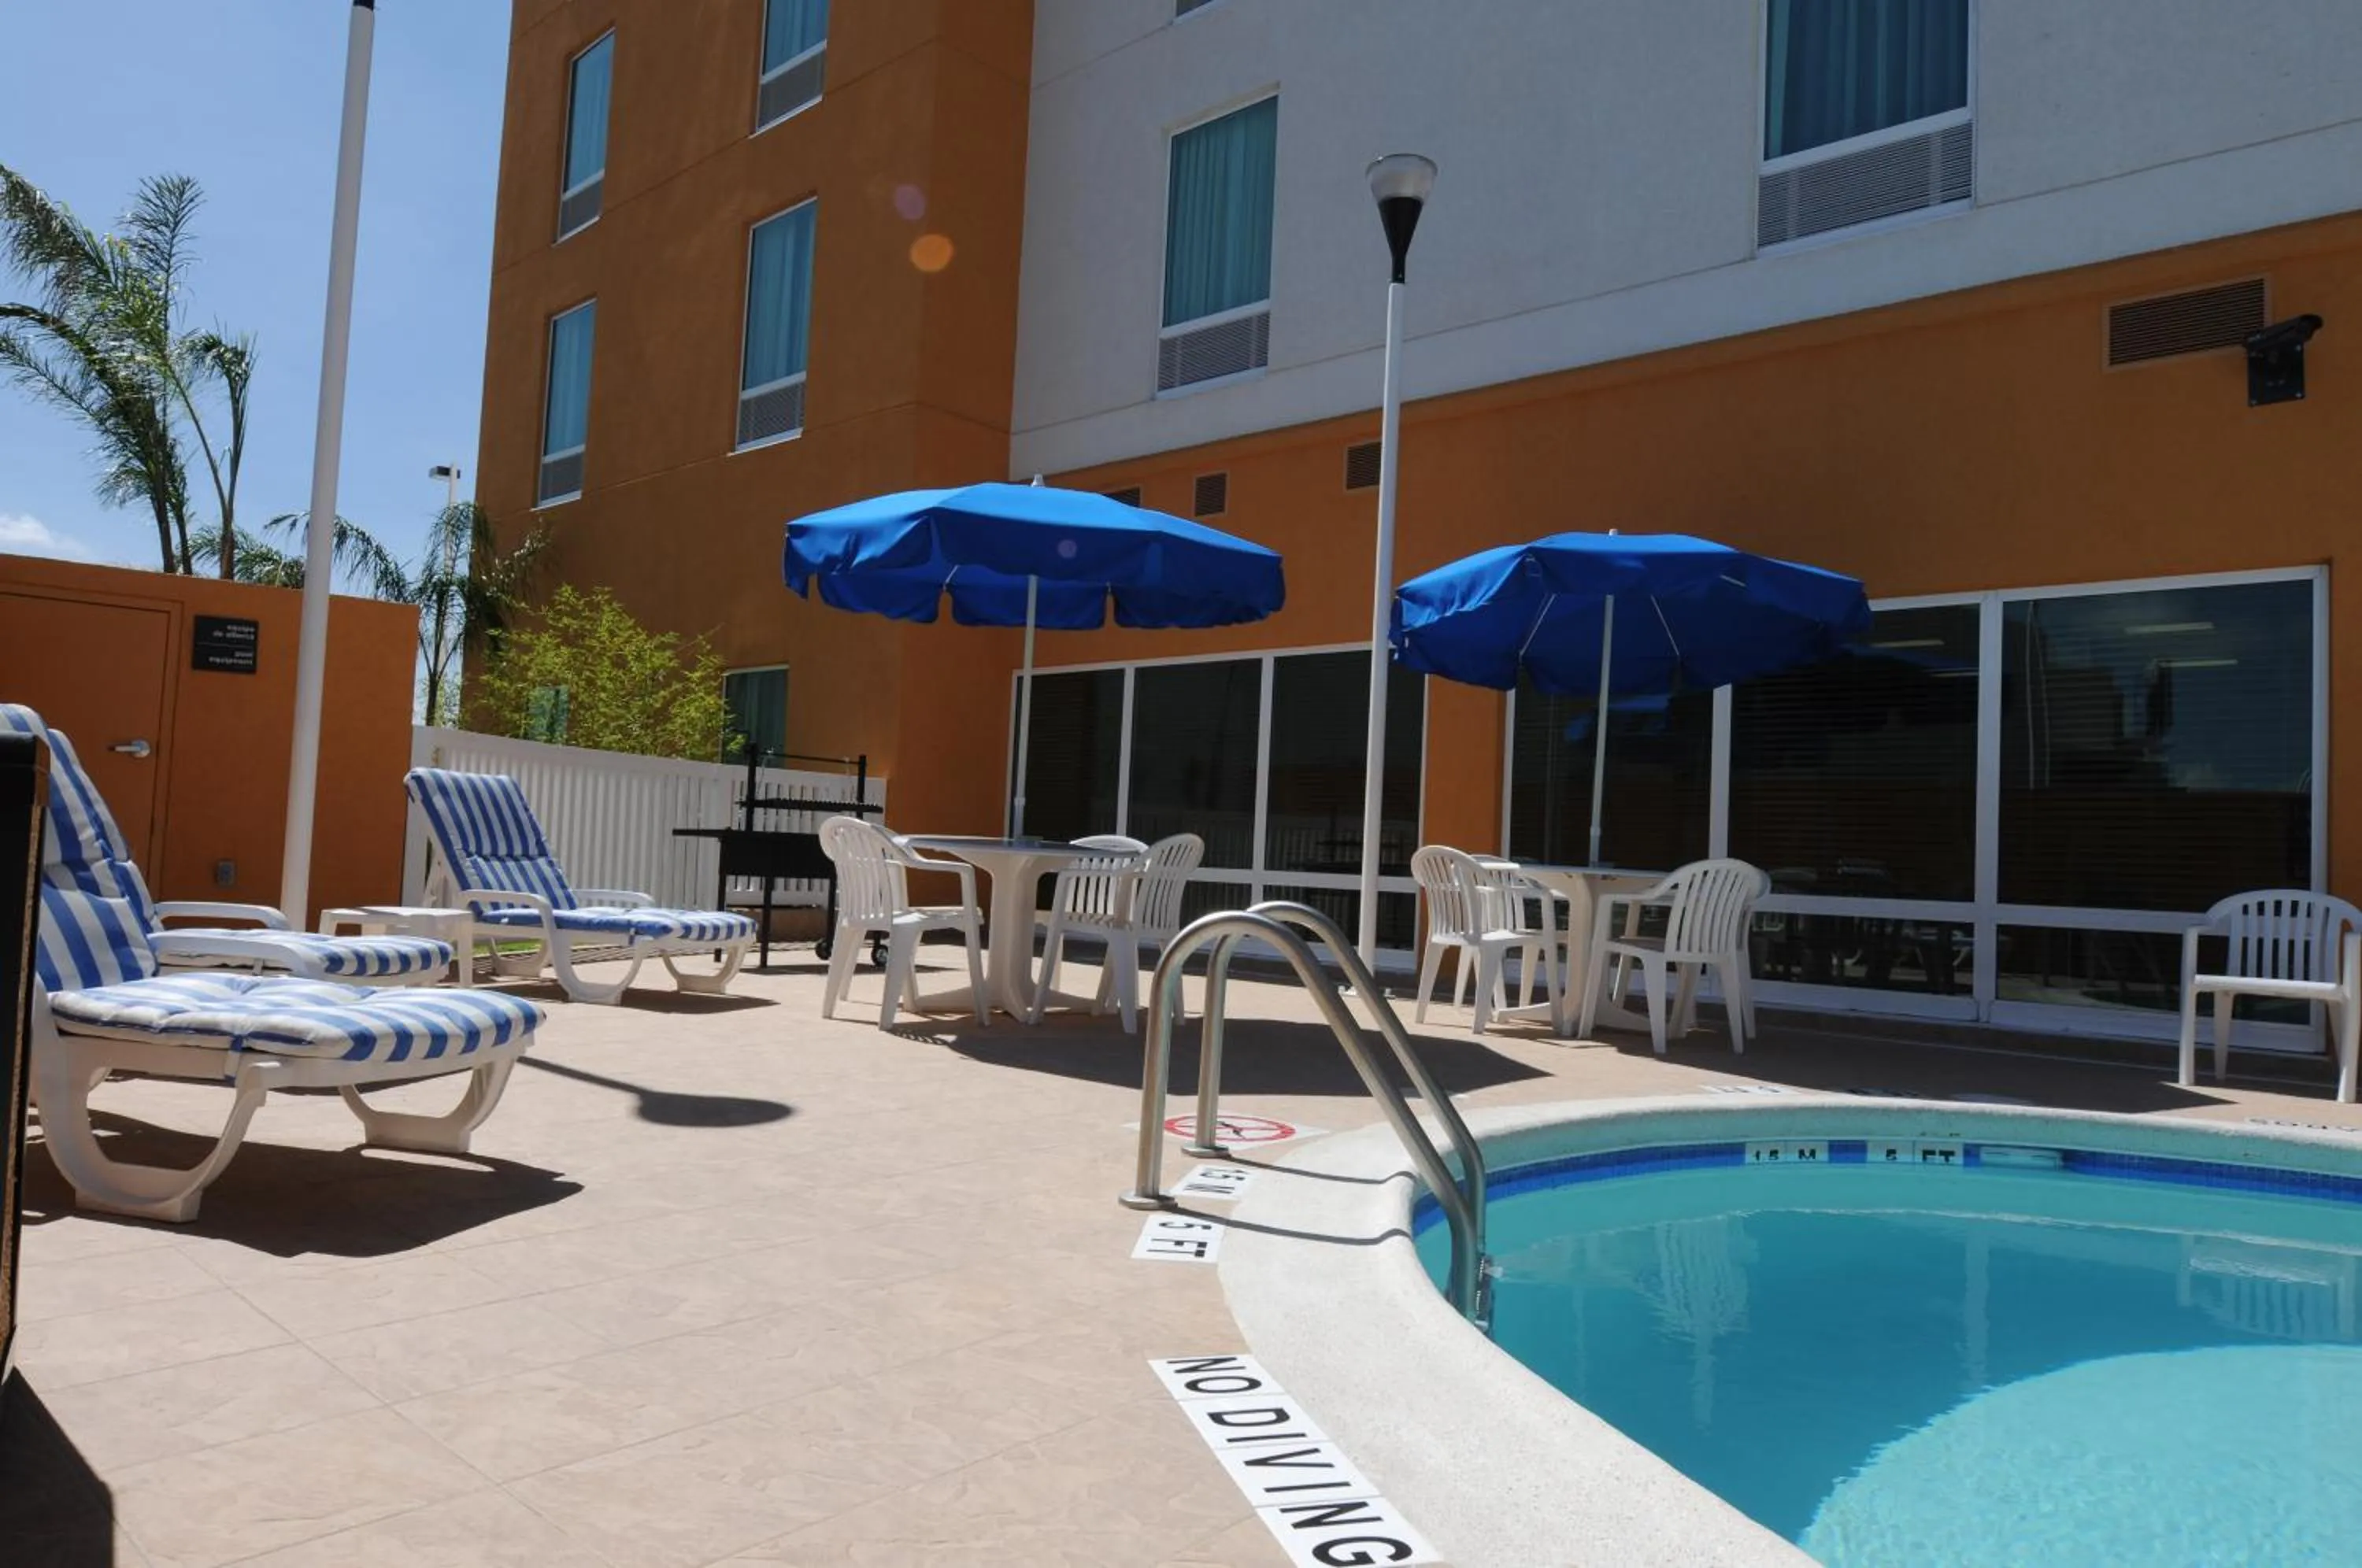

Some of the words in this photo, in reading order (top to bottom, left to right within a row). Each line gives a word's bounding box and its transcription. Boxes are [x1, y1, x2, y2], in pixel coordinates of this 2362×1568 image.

[1797, 1148, 1816, 1159] M
[1922, 1149, 1956, 1163] FT
[1159, 1222, 1212, 1230] 5
[1146, 1238, 1208, 1258] FT
[1166, 1356, 1262, 1394] NO
[1206, 1407, 1413, 1567] DIVING
